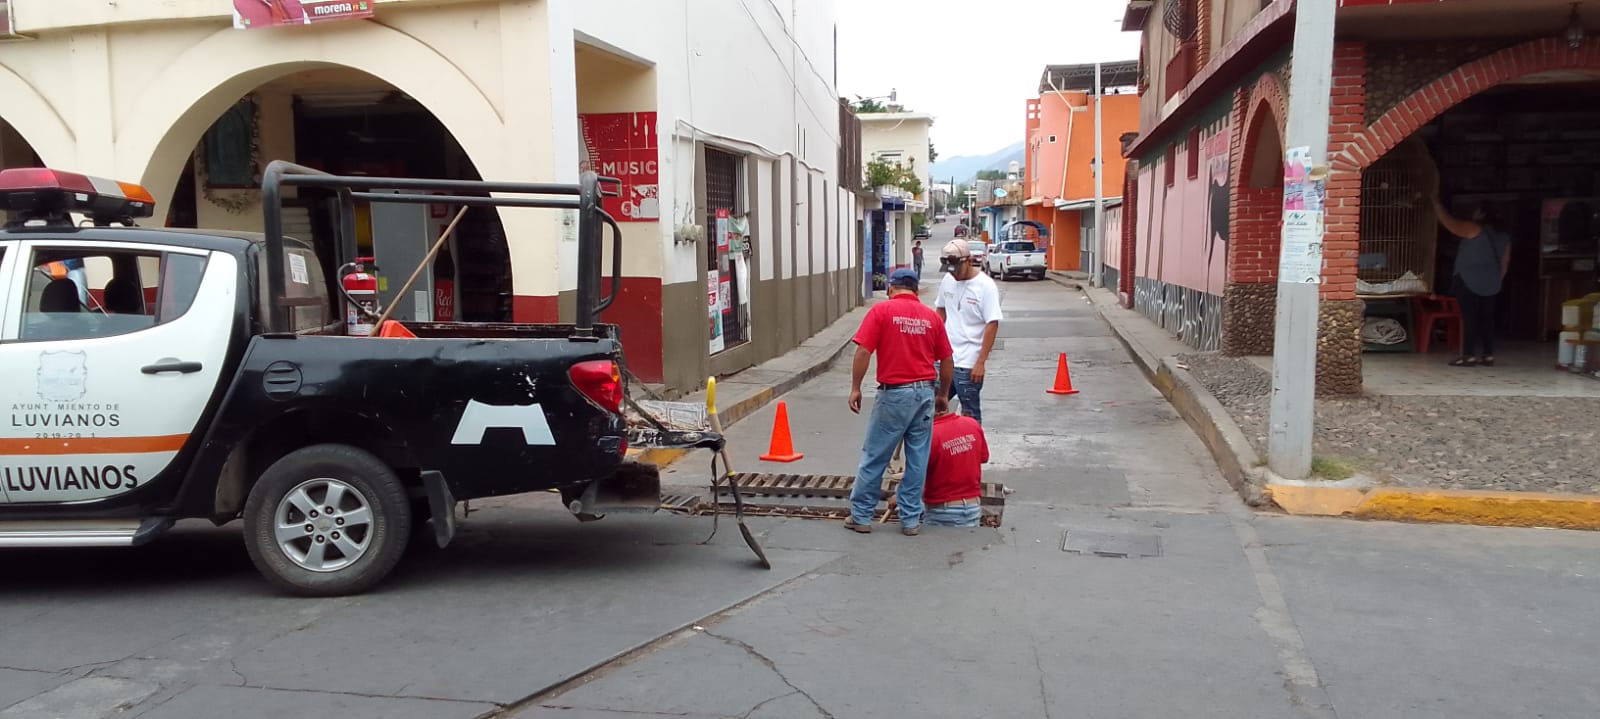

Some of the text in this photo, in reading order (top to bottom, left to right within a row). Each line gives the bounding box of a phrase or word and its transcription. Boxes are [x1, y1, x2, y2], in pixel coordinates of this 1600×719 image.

[314, 3, 352, 15] morena
[603, 160, 657, 175] MUSIC
[12, 403, 120, 411] AYUNTMIENTO DE
[12, 413, 120, 427] LUVIANOS
[5, 464, 138, 492] LUVIANOS
